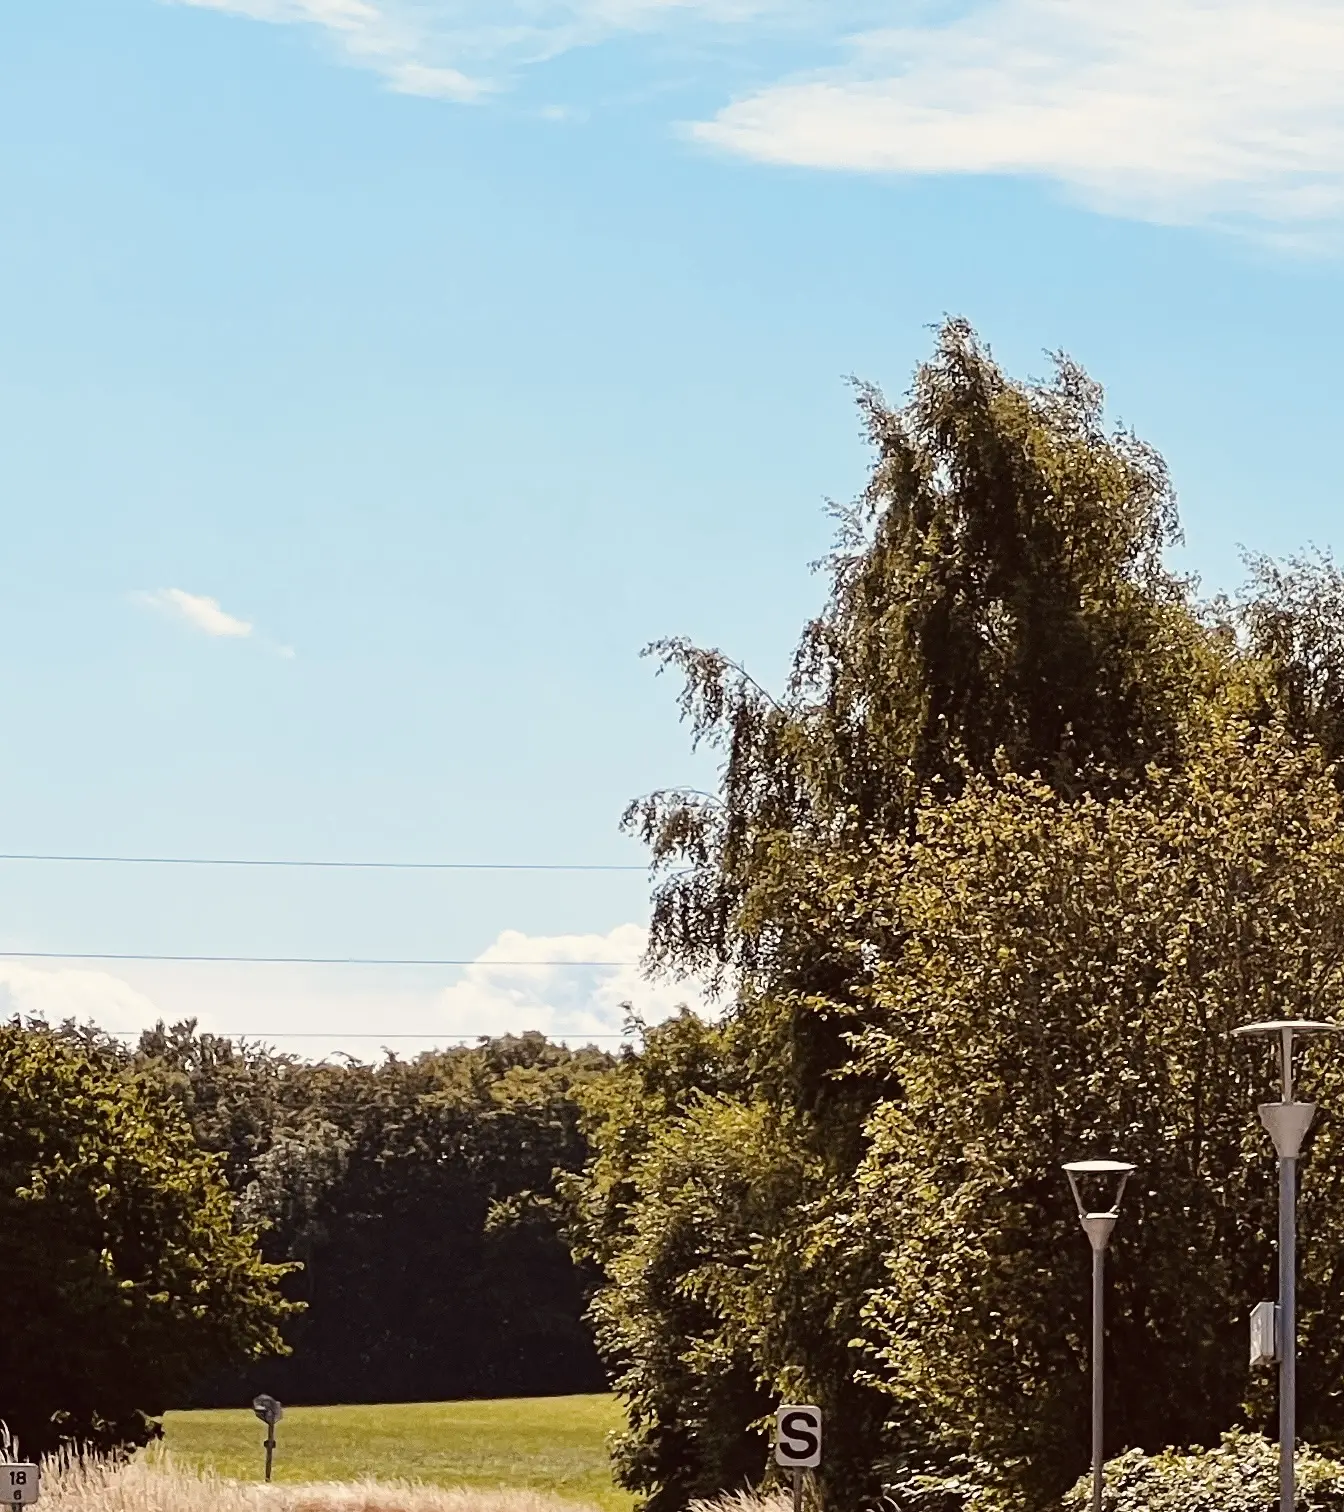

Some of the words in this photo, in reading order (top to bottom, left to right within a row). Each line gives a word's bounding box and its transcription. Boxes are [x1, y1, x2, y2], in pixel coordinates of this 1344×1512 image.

[779, 1411, 818, 1460] S
[9, 1470, 27, 1486] 18
[13, 1489, 22, 1501] 6
